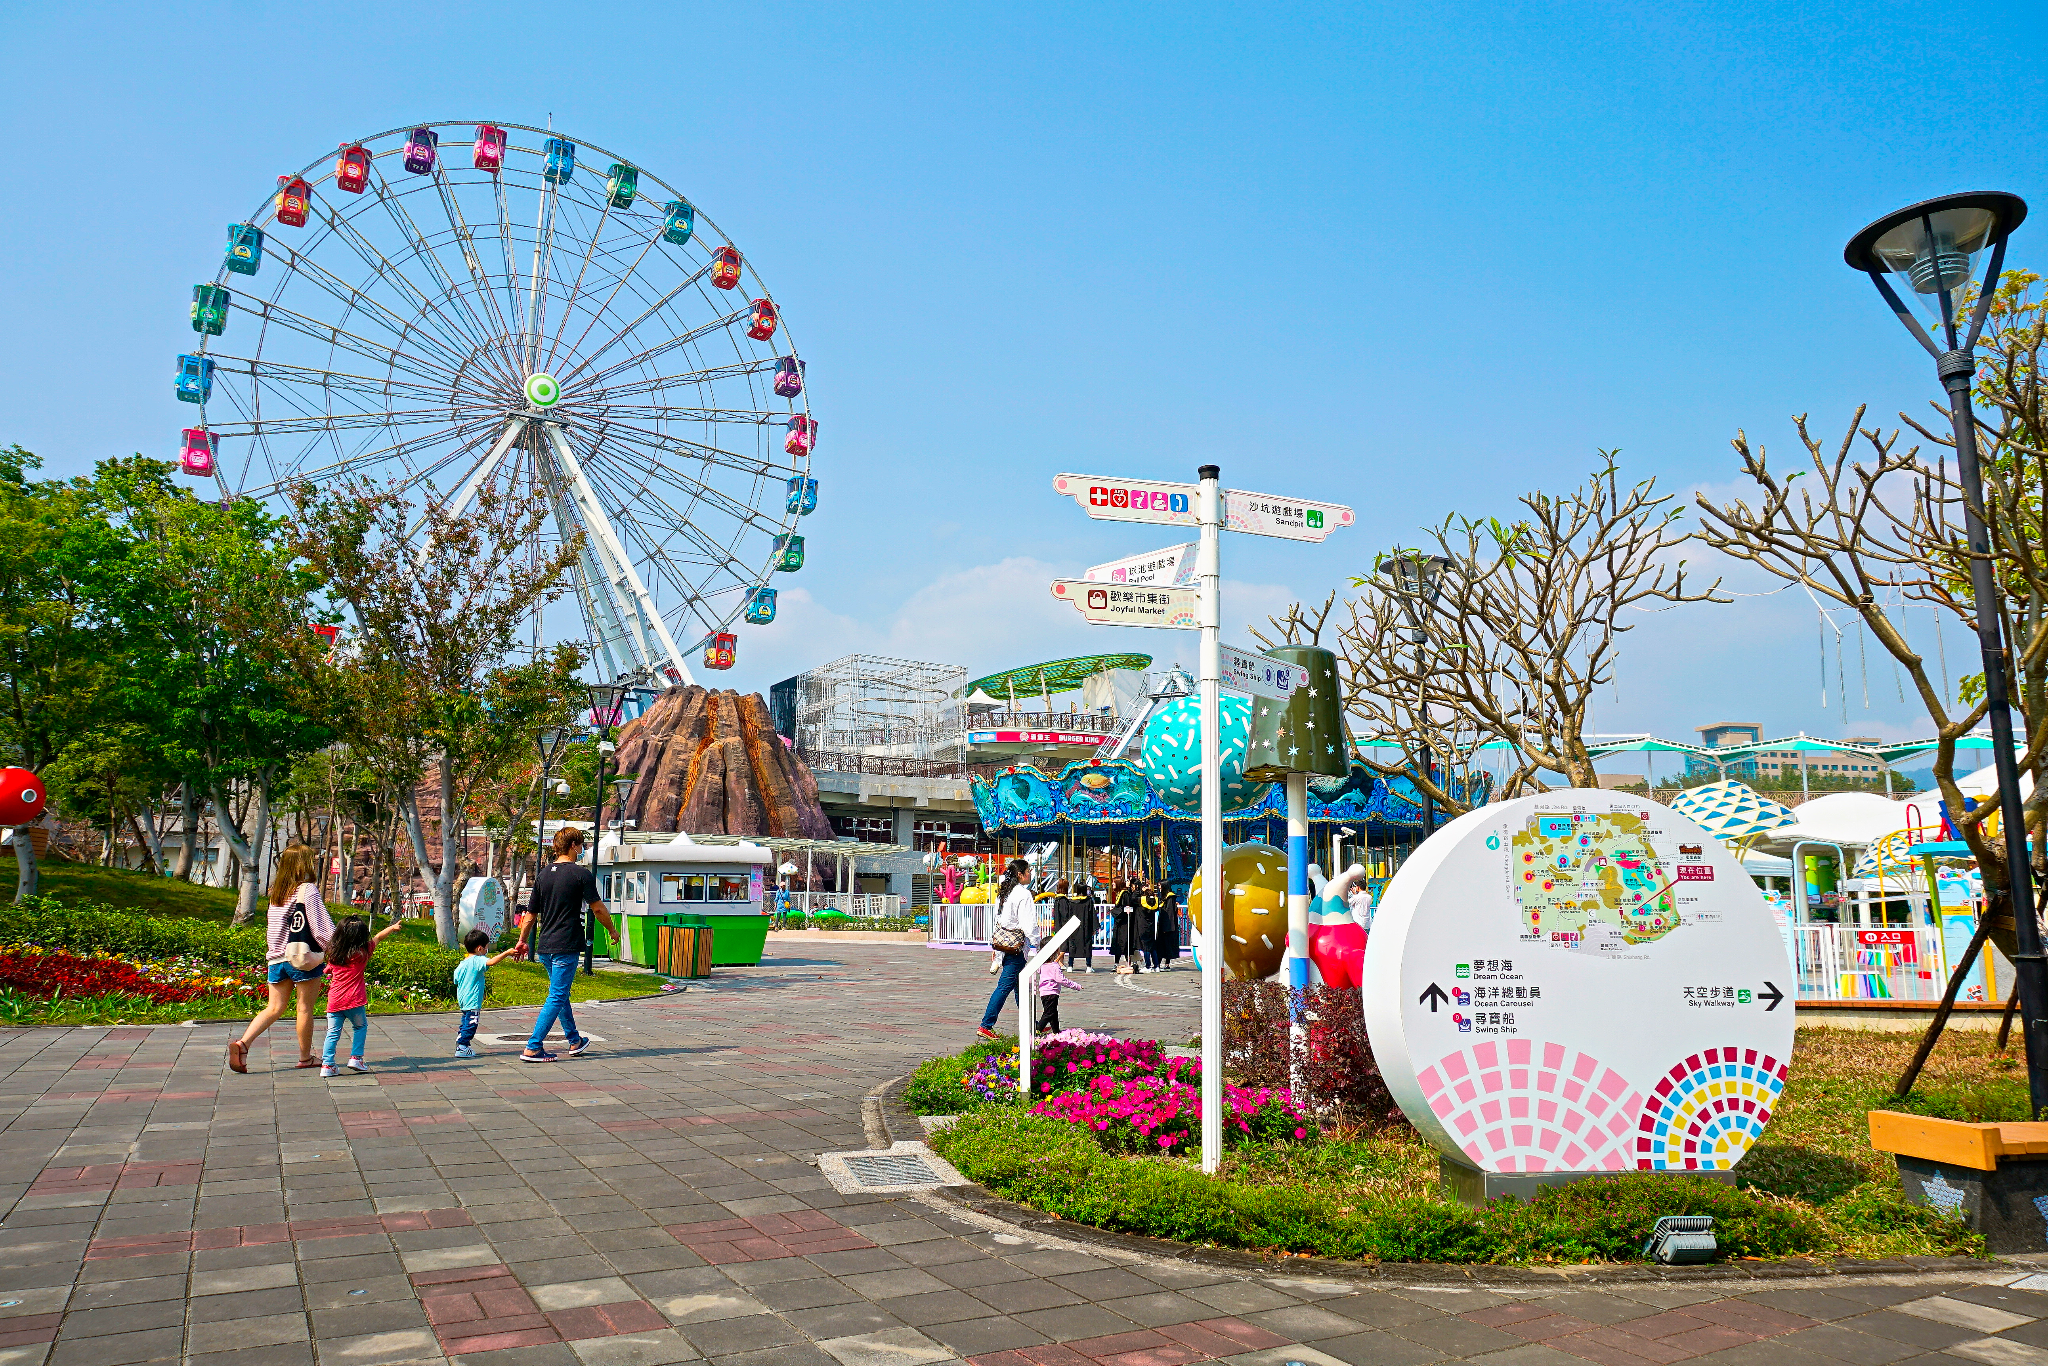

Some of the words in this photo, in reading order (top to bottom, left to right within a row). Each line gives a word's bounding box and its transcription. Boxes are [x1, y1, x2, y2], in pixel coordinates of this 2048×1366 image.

[1249, 501, 1304, 518] 沙坑遊戲場
[1275, 518, 1303, 528] Sandpit
[1110, 590, 1170, 605] 歡樂市集街
[1110, 605, 1136, 614] Joyful
[1138, 606, 1166, 614] Market
[1058, 734, 1083, 743] BURGER
[1084, 736, 1100, 744] KING
[292, 916, 302, 928] H
[1473, 959, 1513, 972] 夢想海
[1474, 986, 1541, 999] 海洋總動員
[1683, 986, 1735, 999] 天空步道
[1688, 999, 1701, 1008] Sky
[1703, 999, 1735, 1008] Walkway
[1475, 1012, 1515, 1025] 尋寶船
[1475, 1026, 1499, 1034] Swing
[1500, 1026, 1518, 1034] Ship
